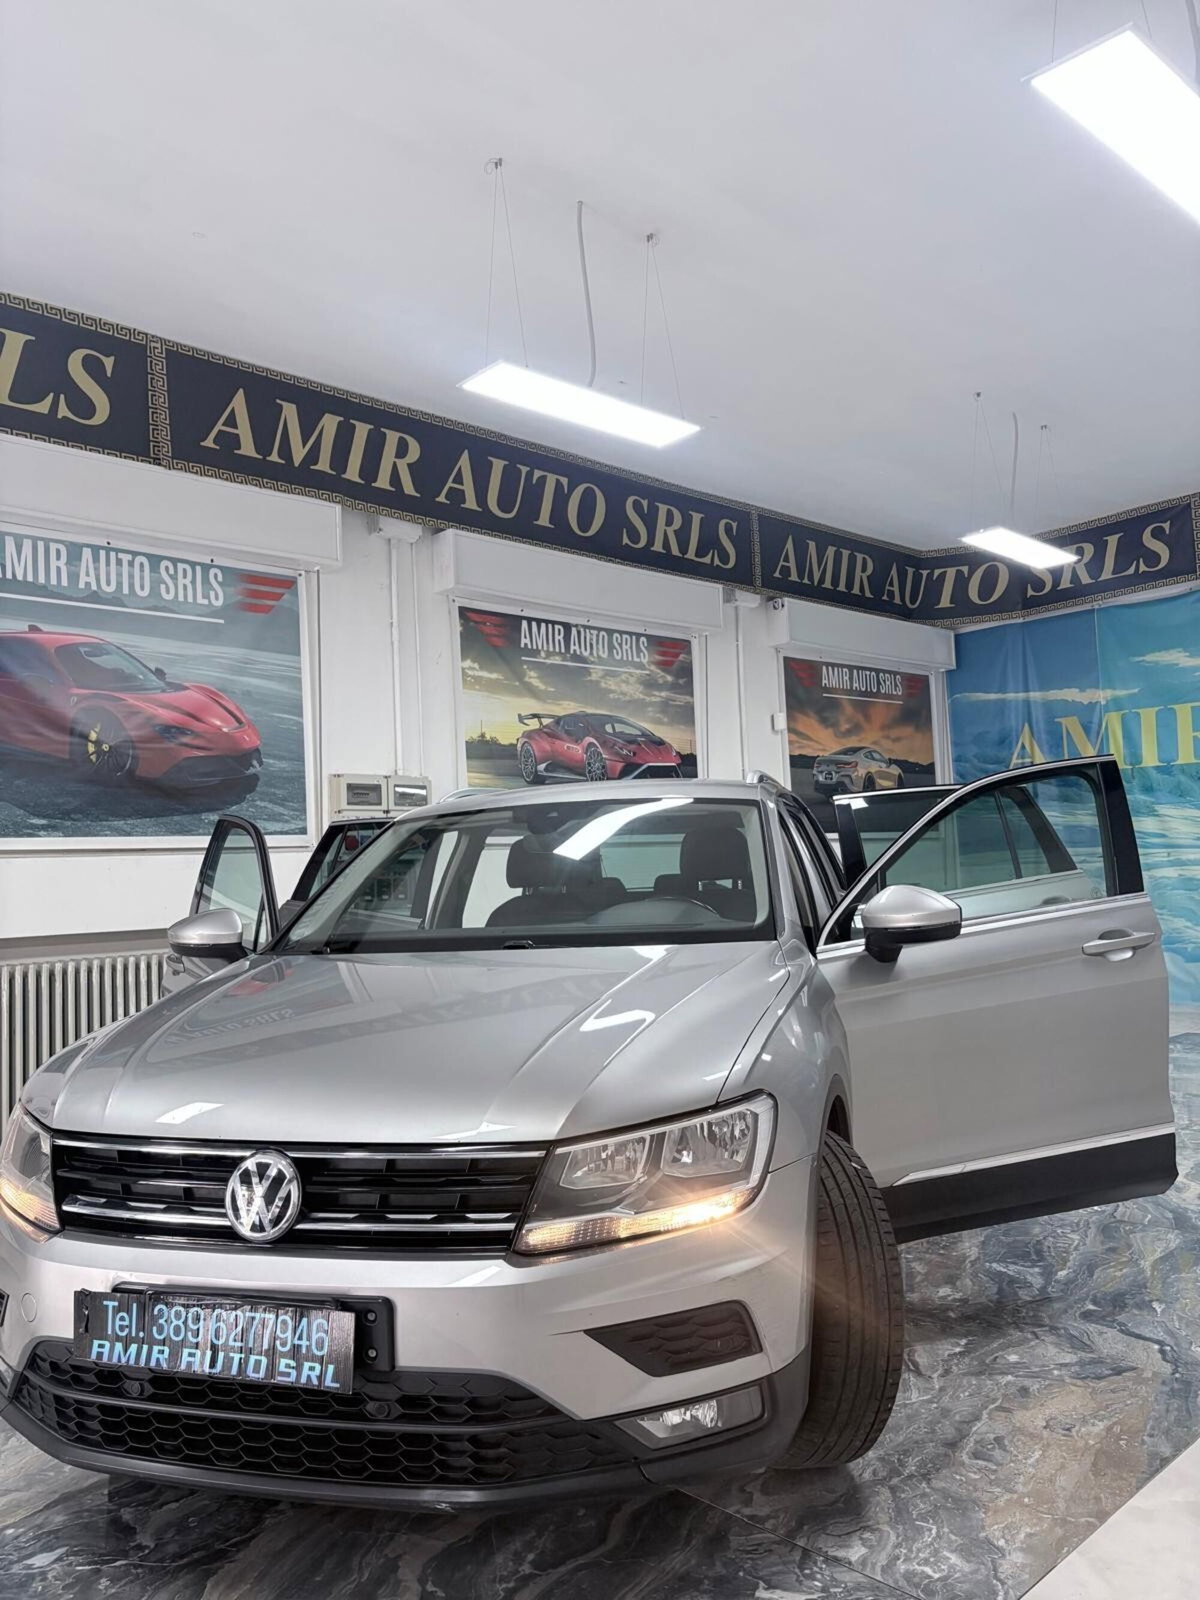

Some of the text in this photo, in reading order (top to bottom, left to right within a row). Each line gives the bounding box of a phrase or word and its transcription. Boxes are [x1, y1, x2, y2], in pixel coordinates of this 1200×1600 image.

[200, 387, 739, 570] AMIR AUTO SRLS
[0, 535, 224, 607] MIR AUTO SRLS
[773, 534, 874, 599] AMIR
[882, 561, 1010, 609] AUTO
[520, 619, 649, 664] AMIR AUTO SRLS
[822, 665, 903, 696] AMIR AUTO SRLS
[103, 1300, 145, 1338] Tel.
[90, 1339, 342, 1389] AMIR AUTO SRL
